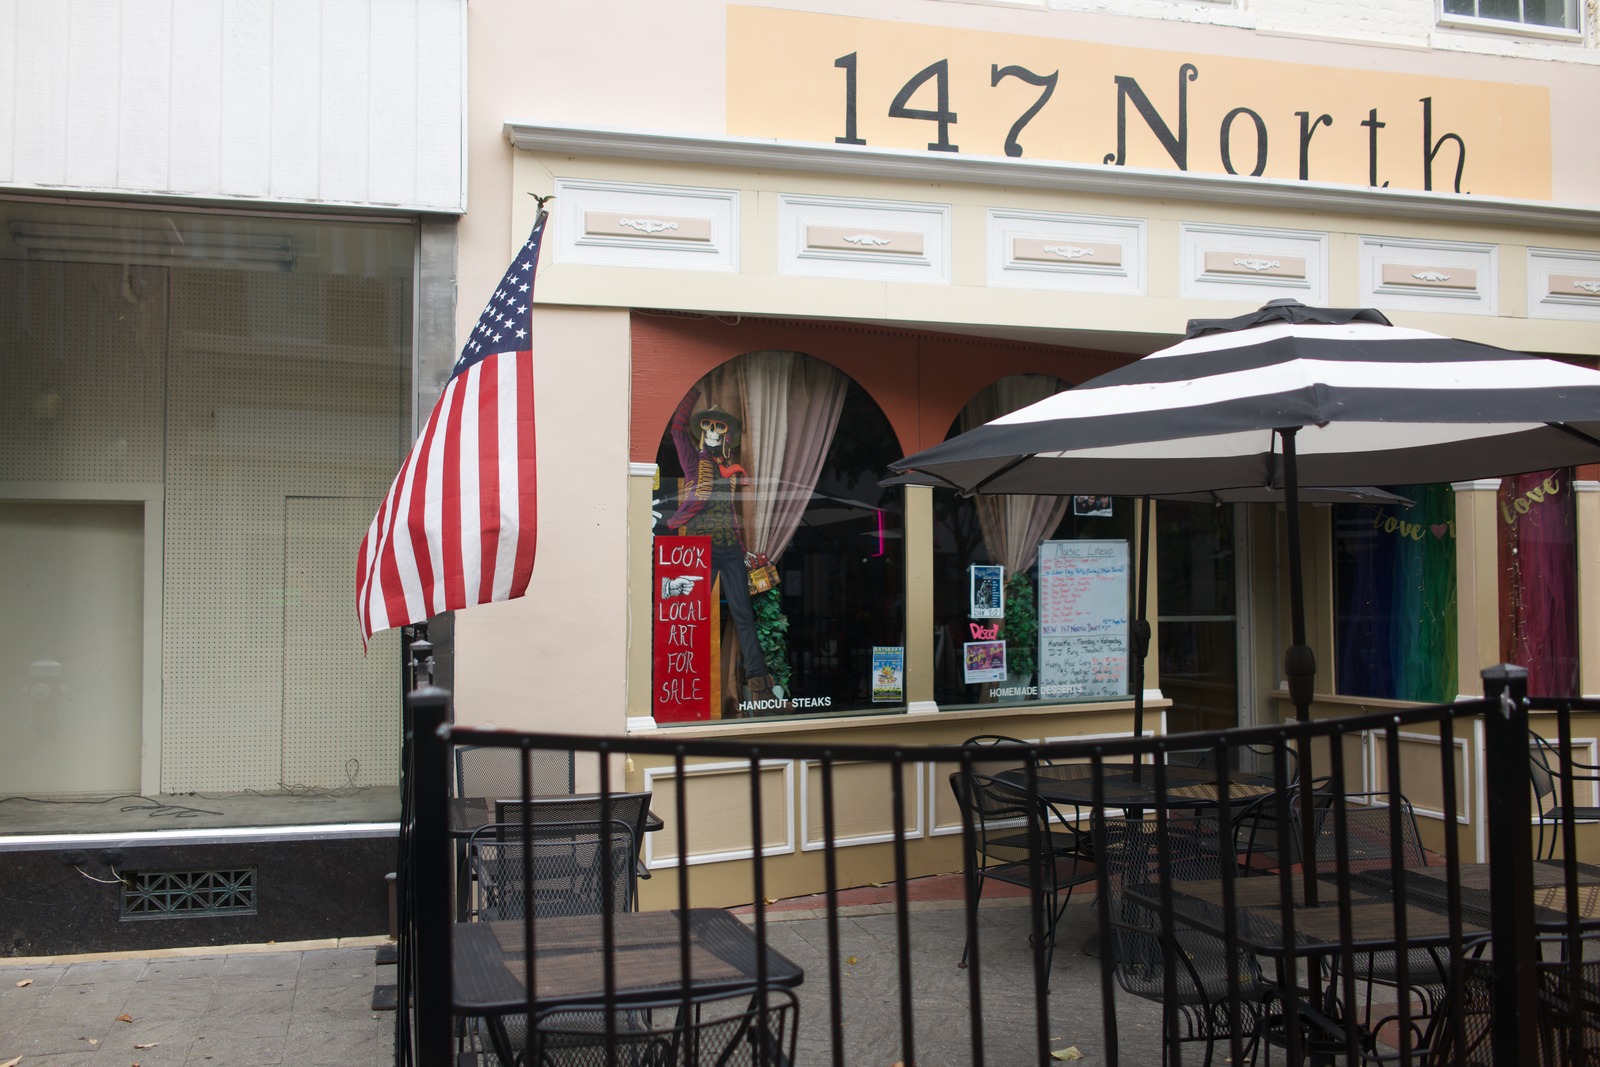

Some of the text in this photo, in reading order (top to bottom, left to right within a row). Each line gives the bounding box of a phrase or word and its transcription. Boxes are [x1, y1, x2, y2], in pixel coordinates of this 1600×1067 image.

[834, 51, 1471, 196] 147 North
[659, 545, 708, 569] LOOK
[1055, 543, 1081, 557] Music
[659, 600, 707, 622] LOCAL
[669, 624, 697, 648] ART
[1043, 625, 1057, 634] NEW
[667, 650, 697, 674] FOR
[660, 678, 703, 704] SALE
[989, 684, 1084, 698] HOMEMADE DESSERTS
[739, 697, 832, 711] HANDCUT STEAKS
